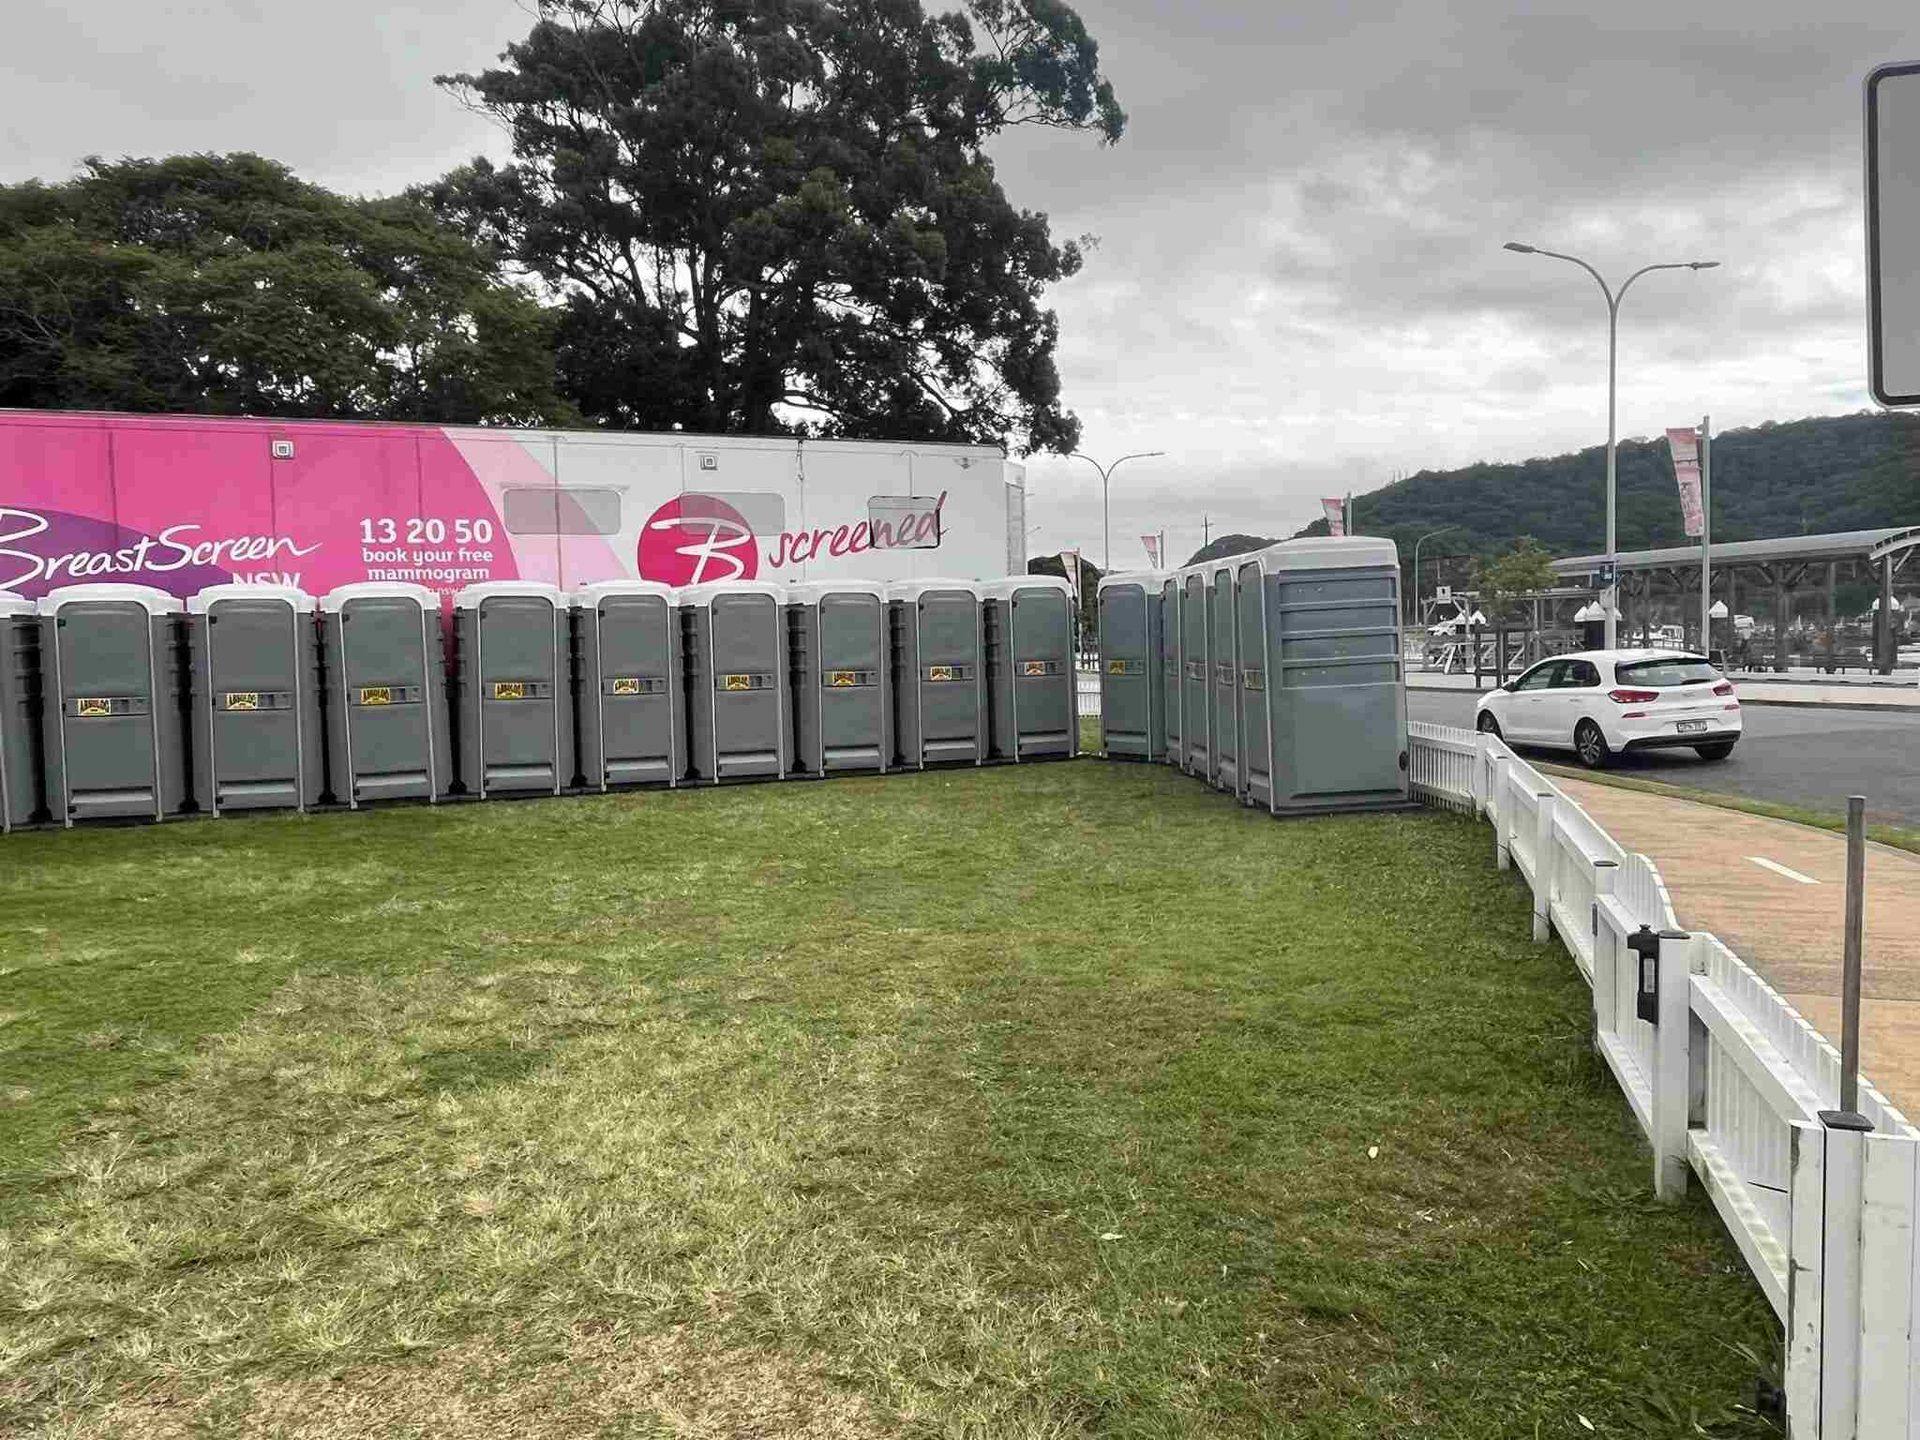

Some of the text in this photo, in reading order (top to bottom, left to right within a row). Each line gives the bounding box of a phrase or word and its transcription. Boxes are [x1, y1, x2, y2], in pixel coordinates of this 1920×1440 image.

[360, 519, 493, 543] 13 20 50
[651, 490, 950, 586] B screened
[362, 547, 493, 565] book your free
[367, 568, 489, 583] mammogram
